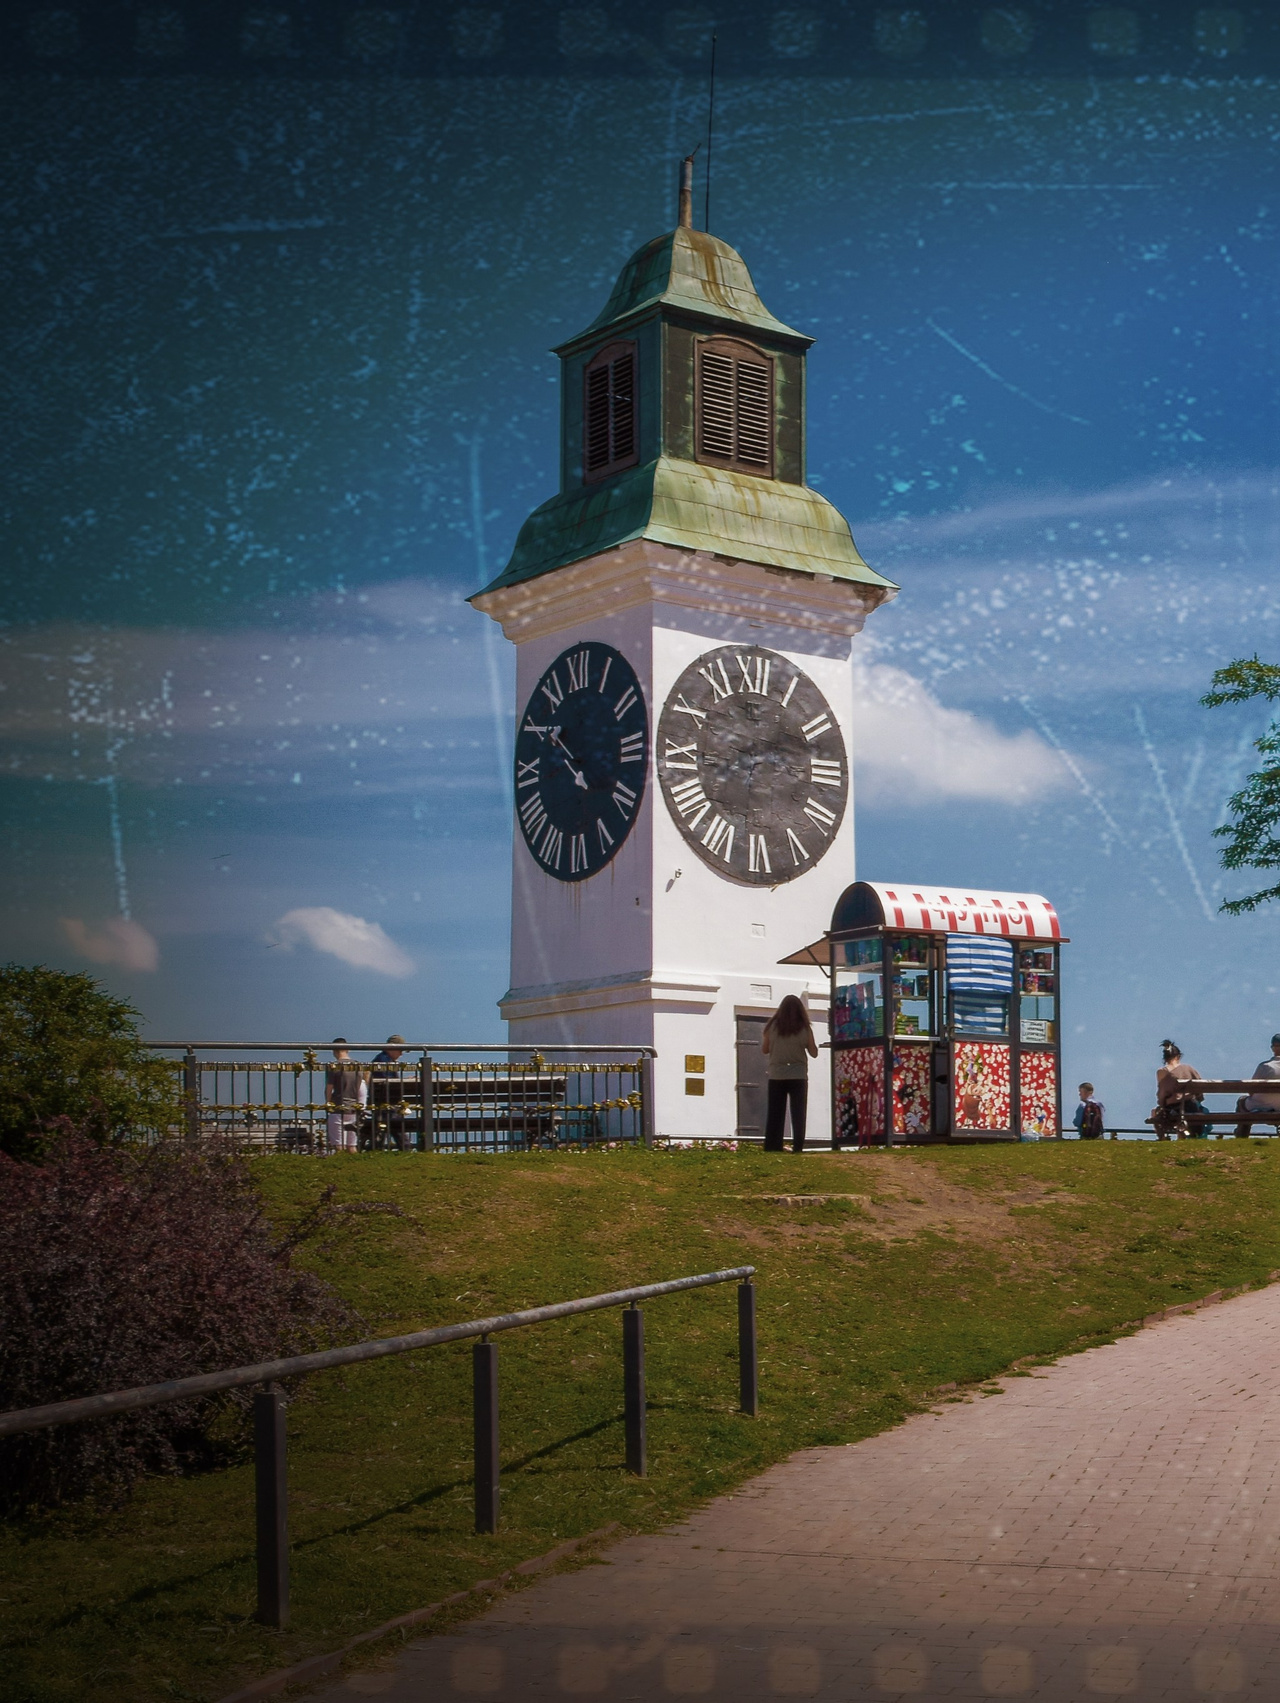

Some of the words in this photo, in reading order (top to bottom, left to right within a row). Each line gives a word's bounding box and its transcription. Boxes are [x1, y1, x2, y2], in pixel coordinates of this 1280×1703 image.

[567, 651, 590, 693] XII
[599, 657, 612, 693] I
[699, 658, 734, 704] XI
[736, 655, 771, 697] XII
[541, 670, 564, 715] XI
[614, 685, 637, 721] II
[780, 676, 799, 708] I
[524, 715, 547, 741] X
[673, 693, 707, 729] X
[801, 713, 832, 742] II
[621, 731, 643, 763] III
[665, 738, 698, 770] IX
[518, 757, 540, 789] IX
[811, 758, 841, 787] III
[598, 818, 614, 855] V
[786, 827, 810, 865] V
